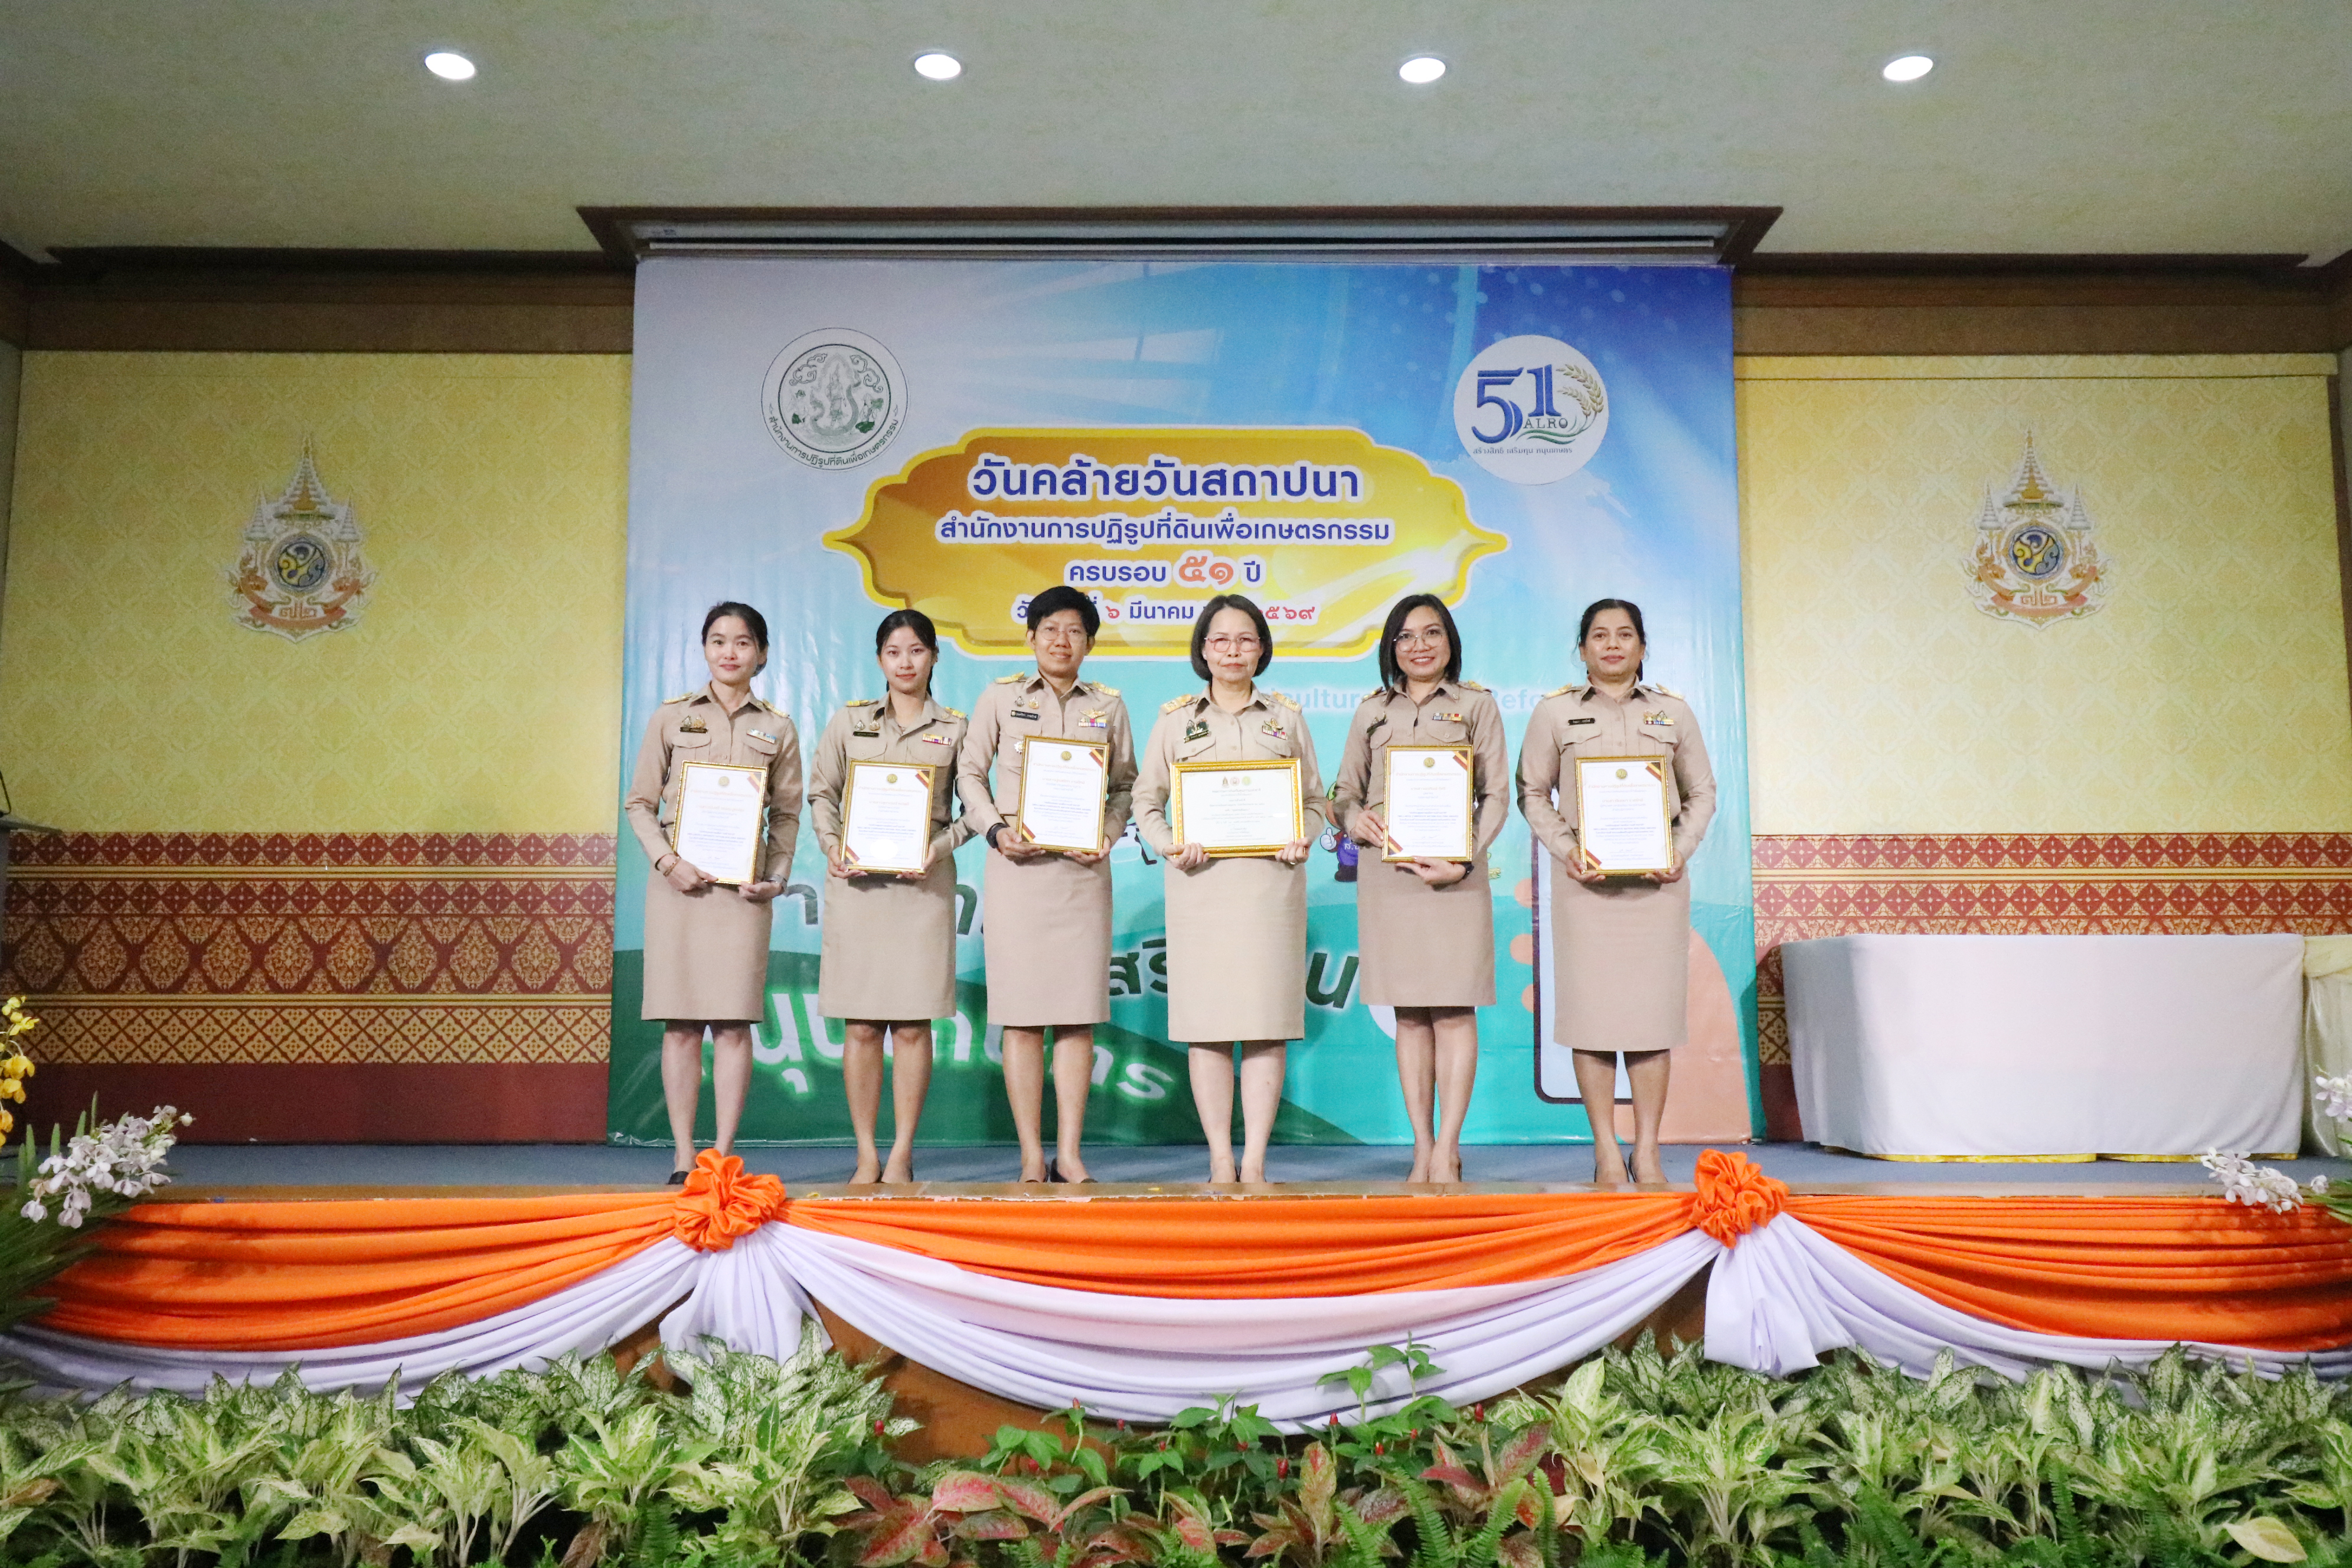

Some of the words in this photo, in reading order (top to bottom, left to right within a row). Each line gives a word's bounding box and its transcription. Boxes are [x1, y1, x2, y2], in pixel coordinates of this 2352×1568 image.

[1471, 364, 1562, 444] 51
[1523, 418, 1569, 429] ALRO
[973, 458, 1358, 498] วันคล้ายวันสถาปนา
[940, 512, 1390, 545] สำนักงานการปฏิรูปที่ดินเพื่อเกษตรกรรม
[1069, 565, 1167, 583] ครบรอบ
[1179, 556, 1234, 584] ๕๑
[1244, 560, 1261, 583] ปี
[1106, 606, 1120, 619] ๖
[1129, 600, 1194, 620] มีนาคม
[1260, 606, 1315, 620] ๕๖๙
